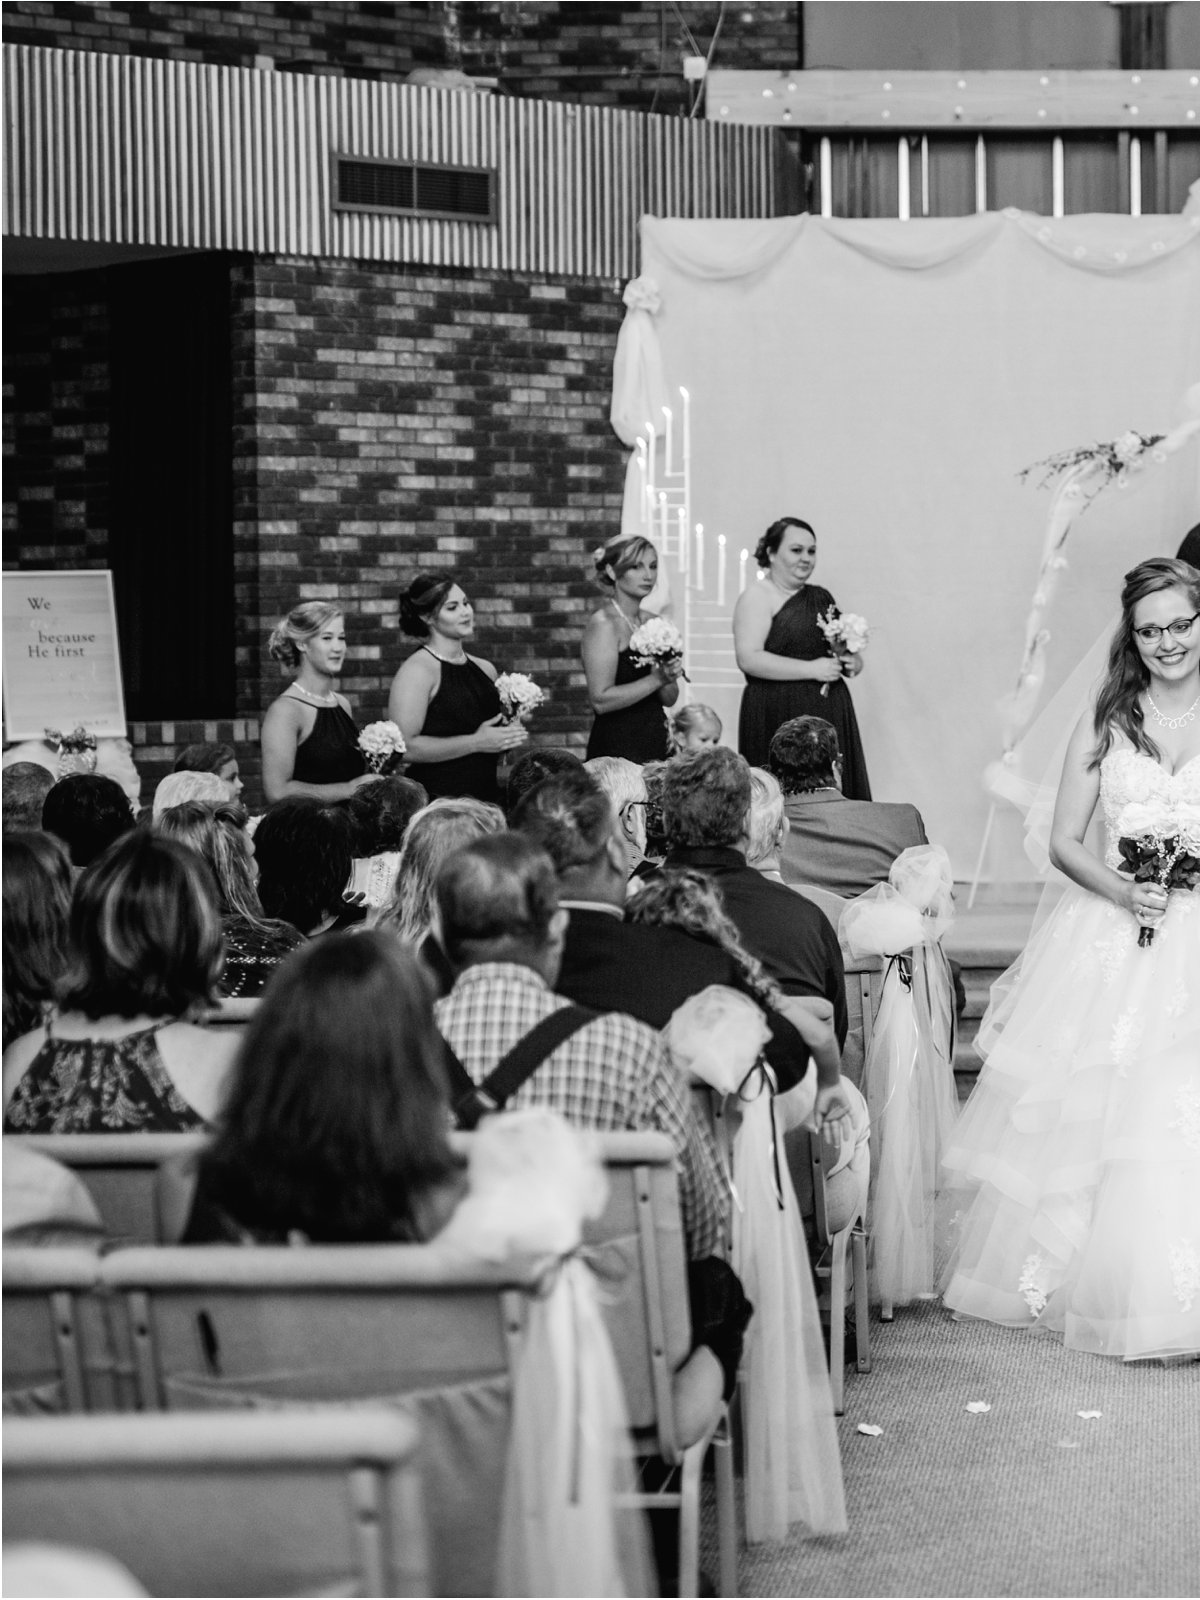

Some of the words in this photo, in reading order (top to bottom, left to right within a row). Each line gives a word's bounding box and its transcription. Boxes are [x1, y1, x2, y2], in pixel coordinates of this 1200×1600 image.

[27, 597, 51, 610] We
[38, 630, 96, 643] because
[28, 645, 49, 658] He
[55, 644, 85, 657] first
